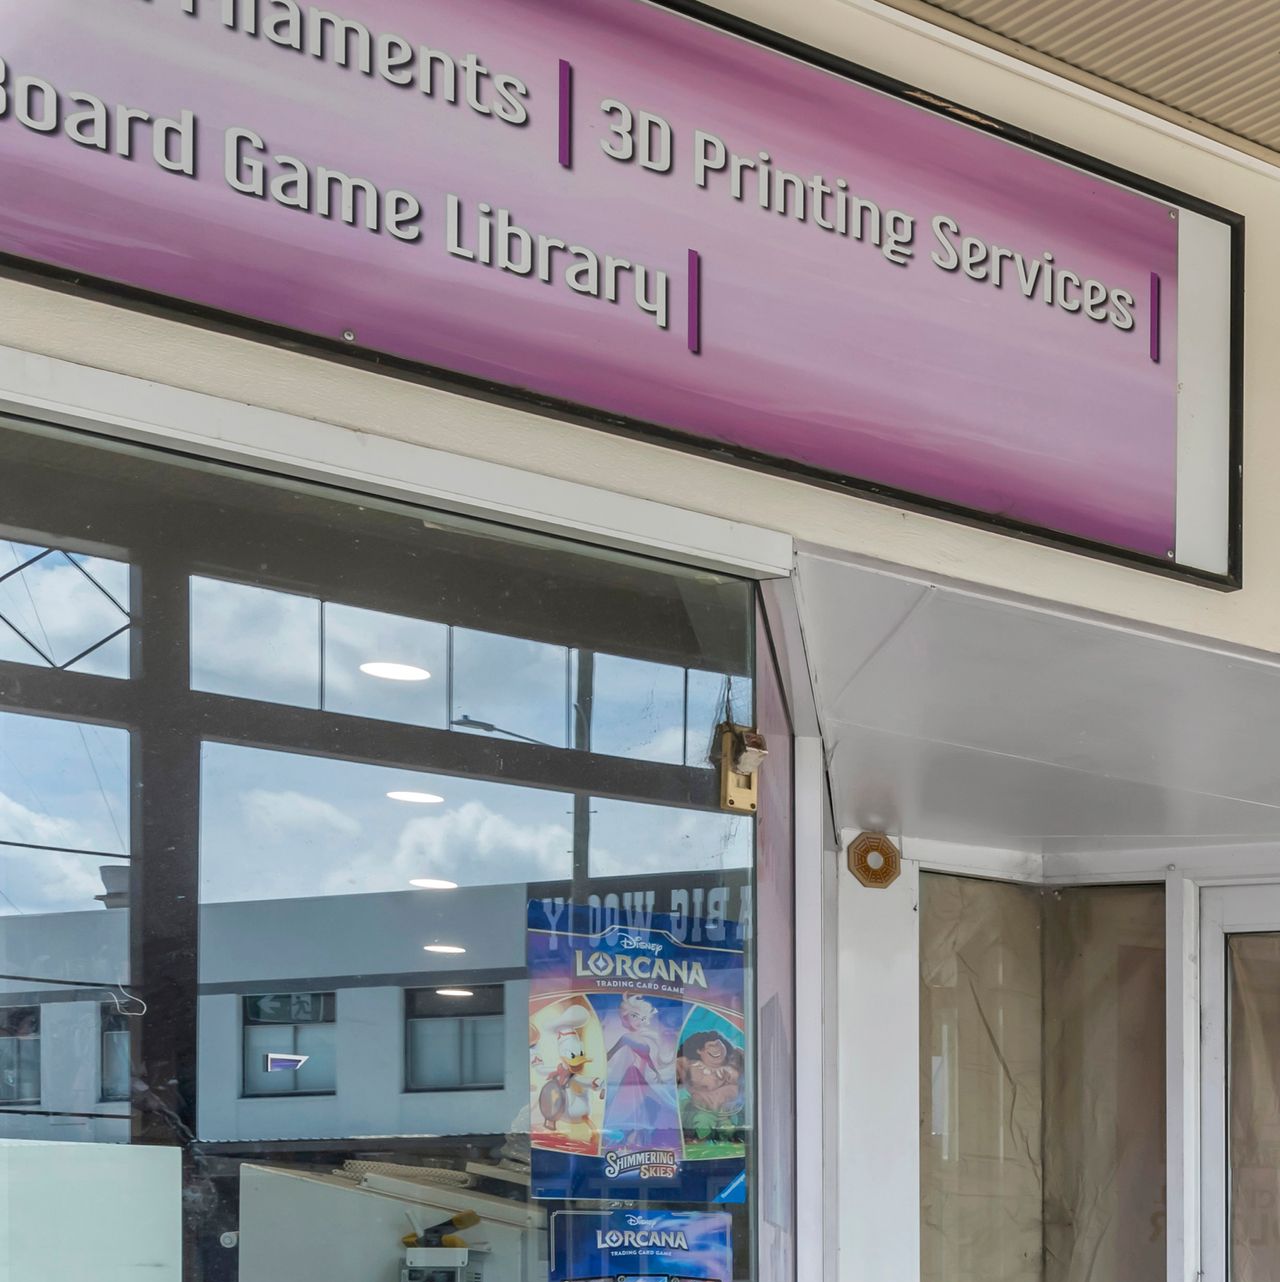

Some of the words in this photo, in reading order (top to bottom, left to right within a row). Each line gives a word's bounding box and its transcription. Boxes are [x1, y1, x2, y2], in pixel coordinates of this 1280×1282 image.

[183, 0, 528, 125] aments
[601, 98, 673, 173] 3D
[695, 128, 914, 264] Printing
[930, 214, 1134, 330] Services
[0, 56, 194, 177] oard
[225, 127, 421, 241] Game
[447, 193, 667, 328] Library
[575, 950, 709, 989] LORCANA
[596, 980, 634, 989] TRADING
[636, 982, 659, 990] CARD
[661, 985, 685, 994] GAME
[640, 1164, 674, 1179] SKIES
[596, 1230, 689, 1250] LORCANA
